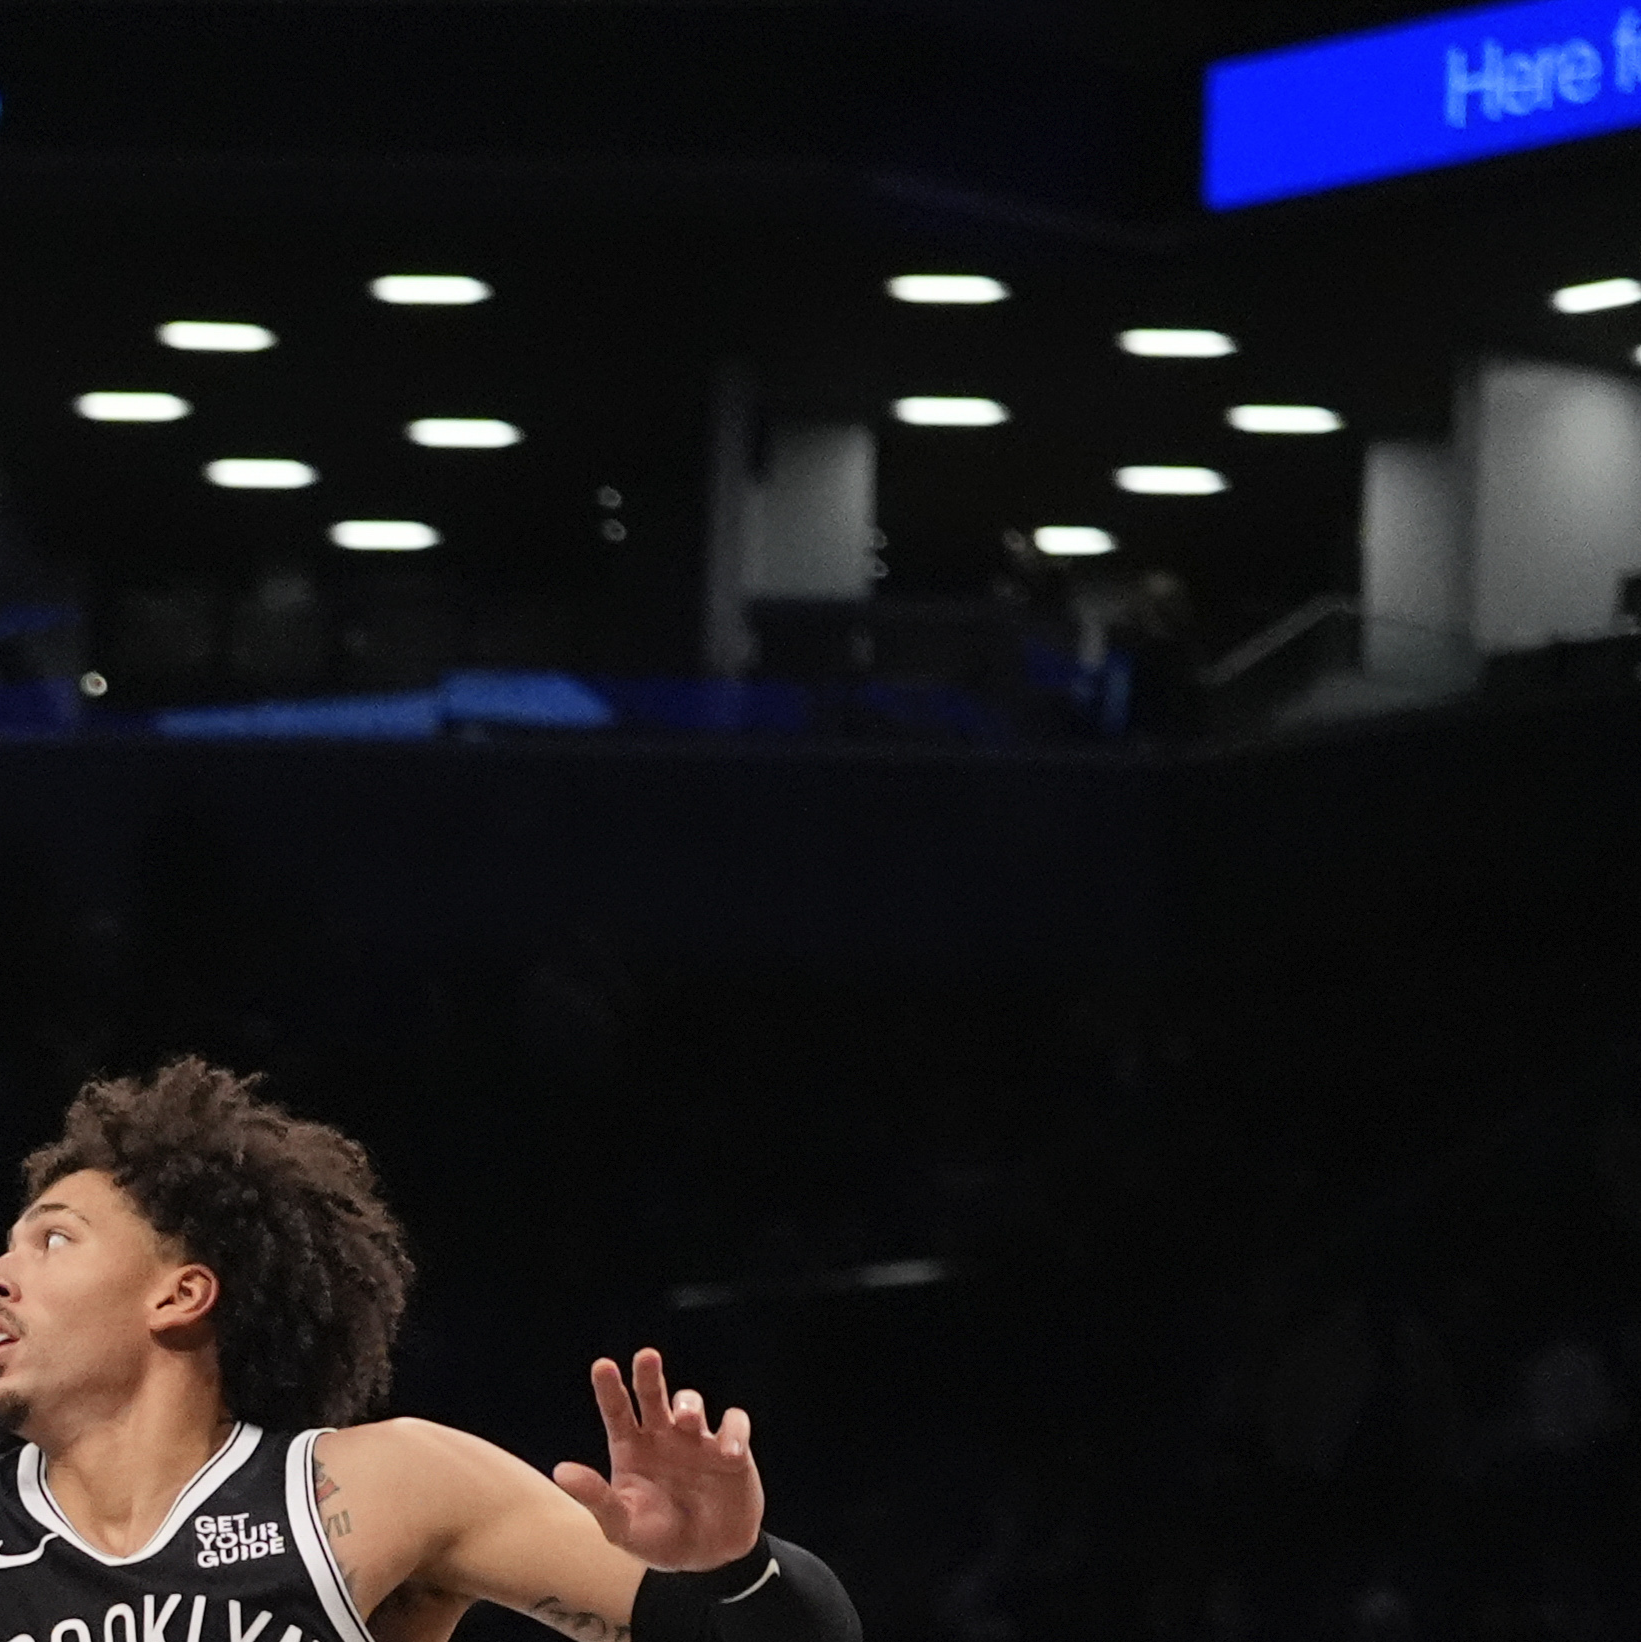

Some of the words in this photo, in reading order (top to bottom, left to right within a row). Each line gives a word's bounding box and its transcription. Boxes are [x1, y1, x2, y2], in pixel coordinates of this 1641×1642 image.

[1443, 36, 1604, 128] Here
[194, 1512, 250, 1535] GET
[196, 1521, 279, 1551] YOUR
[197, 1535, 286, 1569] GUIDE
